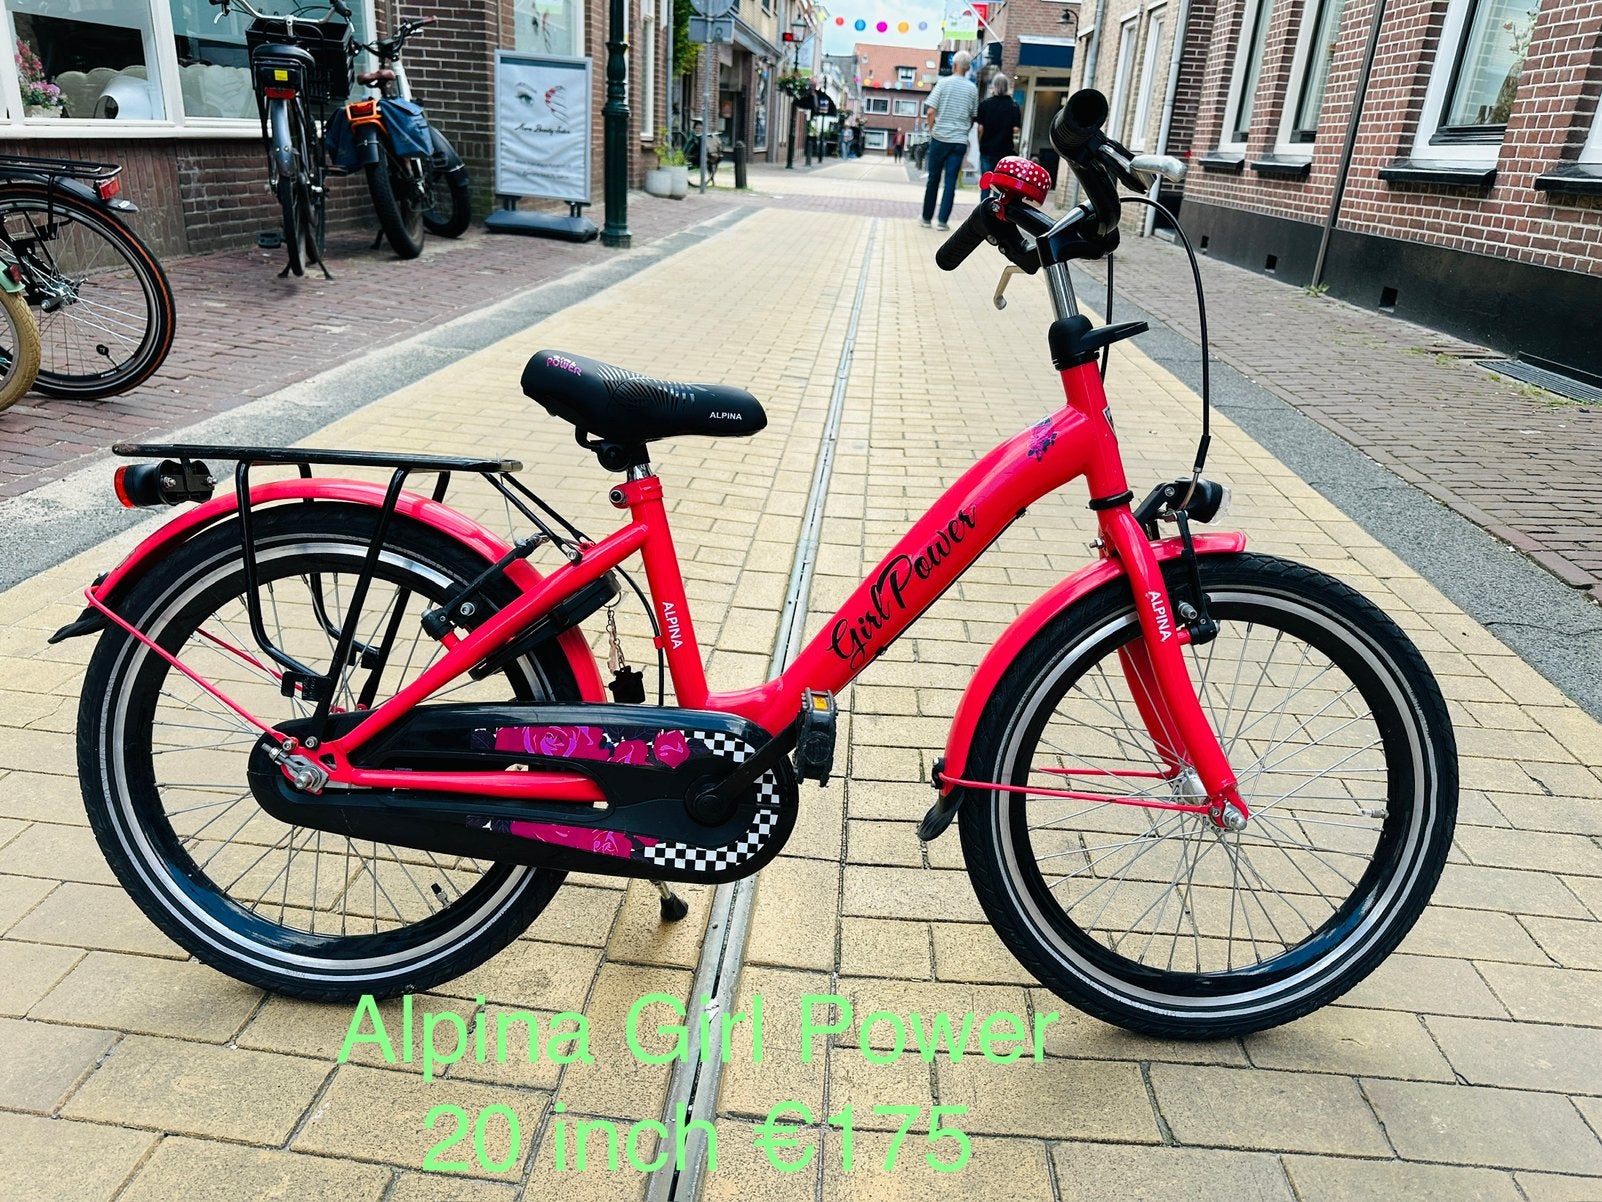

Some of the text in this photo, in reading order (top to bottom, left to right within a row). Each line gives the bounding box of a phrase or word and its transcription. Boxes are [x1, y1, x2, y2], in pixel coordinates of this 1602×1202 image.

[546, 357, 582, 377] POWER
[709, 411, 743, 421] ALPINA
[826, 503, 977, 671] Girl Power
[662, 601, 684, 650] ALPINA
[1147, 591, 1172, 642] ALPINA
